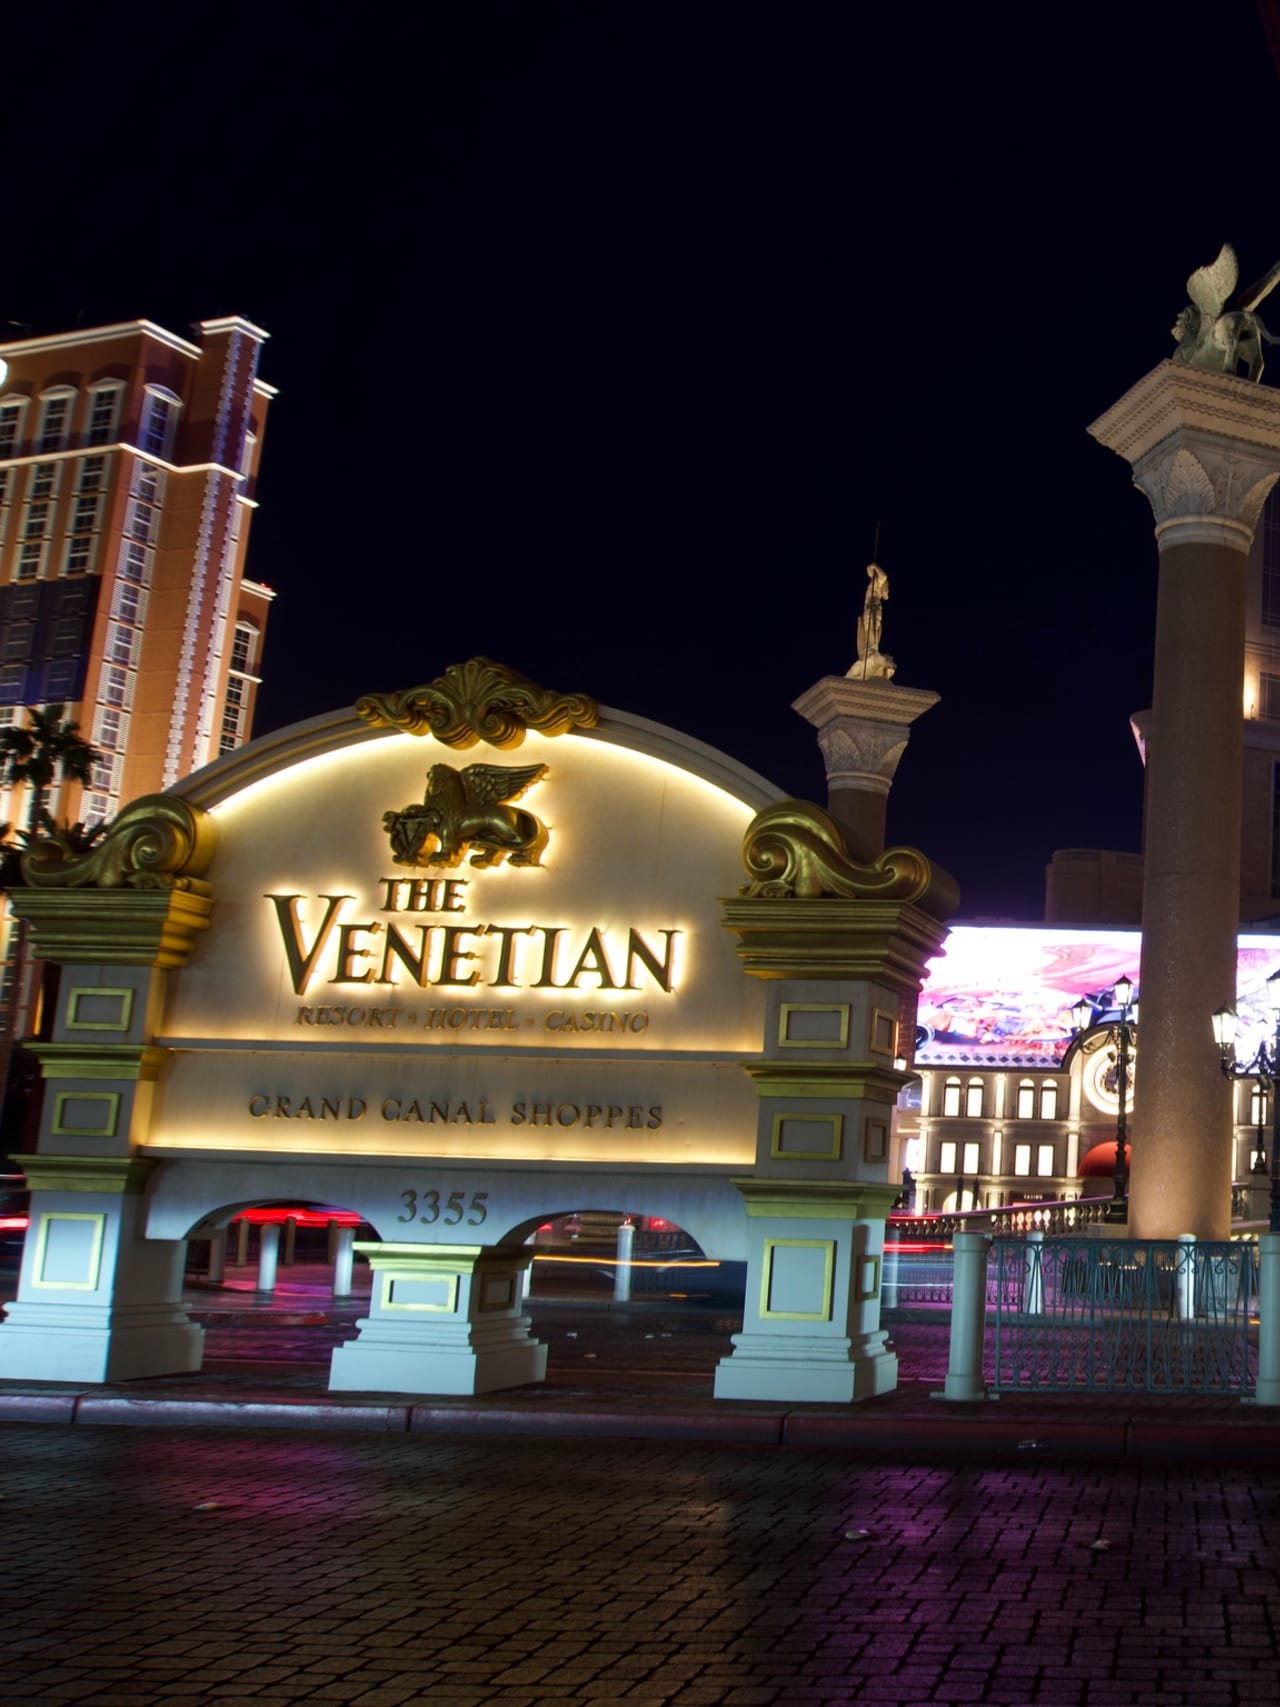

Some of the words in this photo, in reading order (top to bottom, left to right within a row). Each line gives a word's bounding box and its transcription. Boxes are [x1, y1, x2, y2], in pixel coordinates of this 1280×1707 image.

[379, 877, 469, 913] THE
[263, 893, 684, 996] VENETIAN
[296, 1006, 401, 1029] RESORT
[424, 1007, 518, 1031] HOTEL
[543, 1010, 650, 1035] CASINO
[248, 1095, 368, 1121] GRAND
[380, 1099, 497, 1125] CANAL
[510, 1101, 665, 1130] SHOPPES
[397, 1189, 489, 1226] 3355
